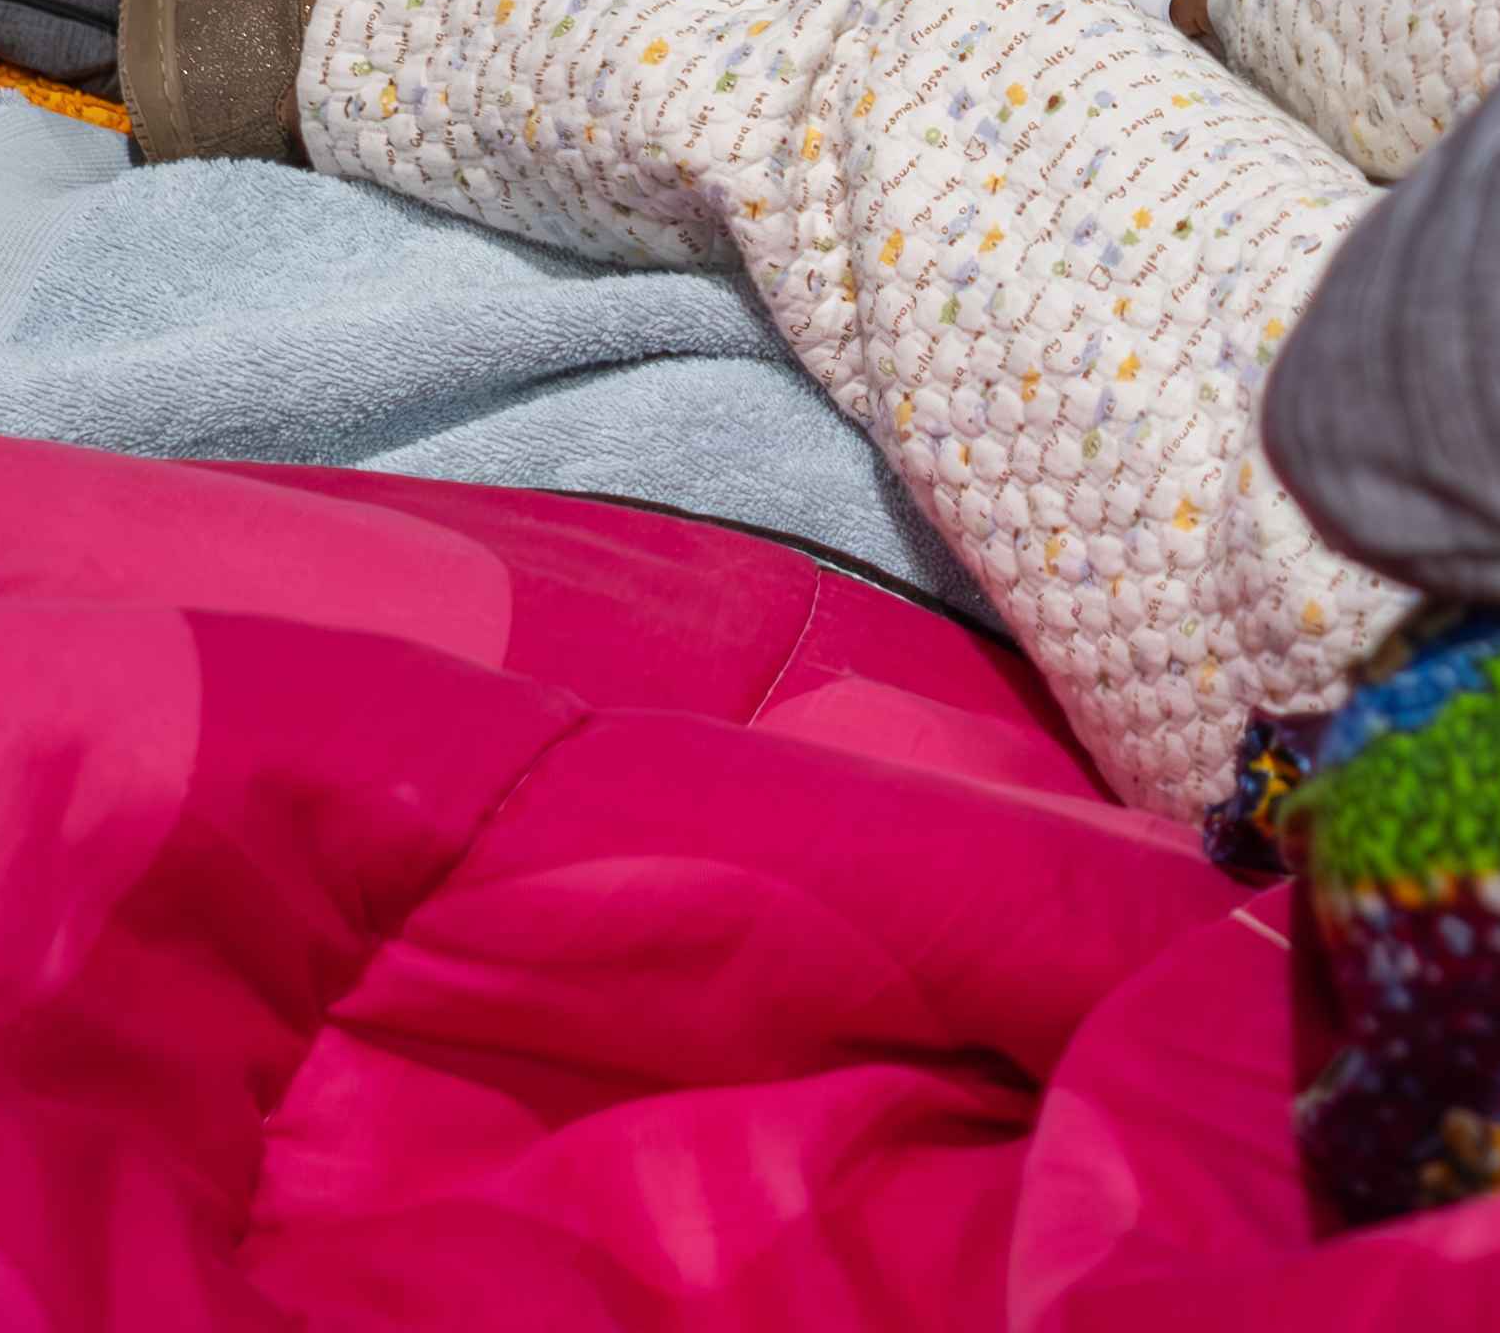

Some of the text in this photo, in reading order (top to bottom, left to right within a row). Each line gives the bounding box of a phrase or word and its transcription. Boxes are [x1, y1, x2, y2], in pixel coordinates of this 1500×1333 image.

[884, 8, 953, 77] best flower
[684, 106, 714, 148] ballet
[728, 127, 750, 163] book
